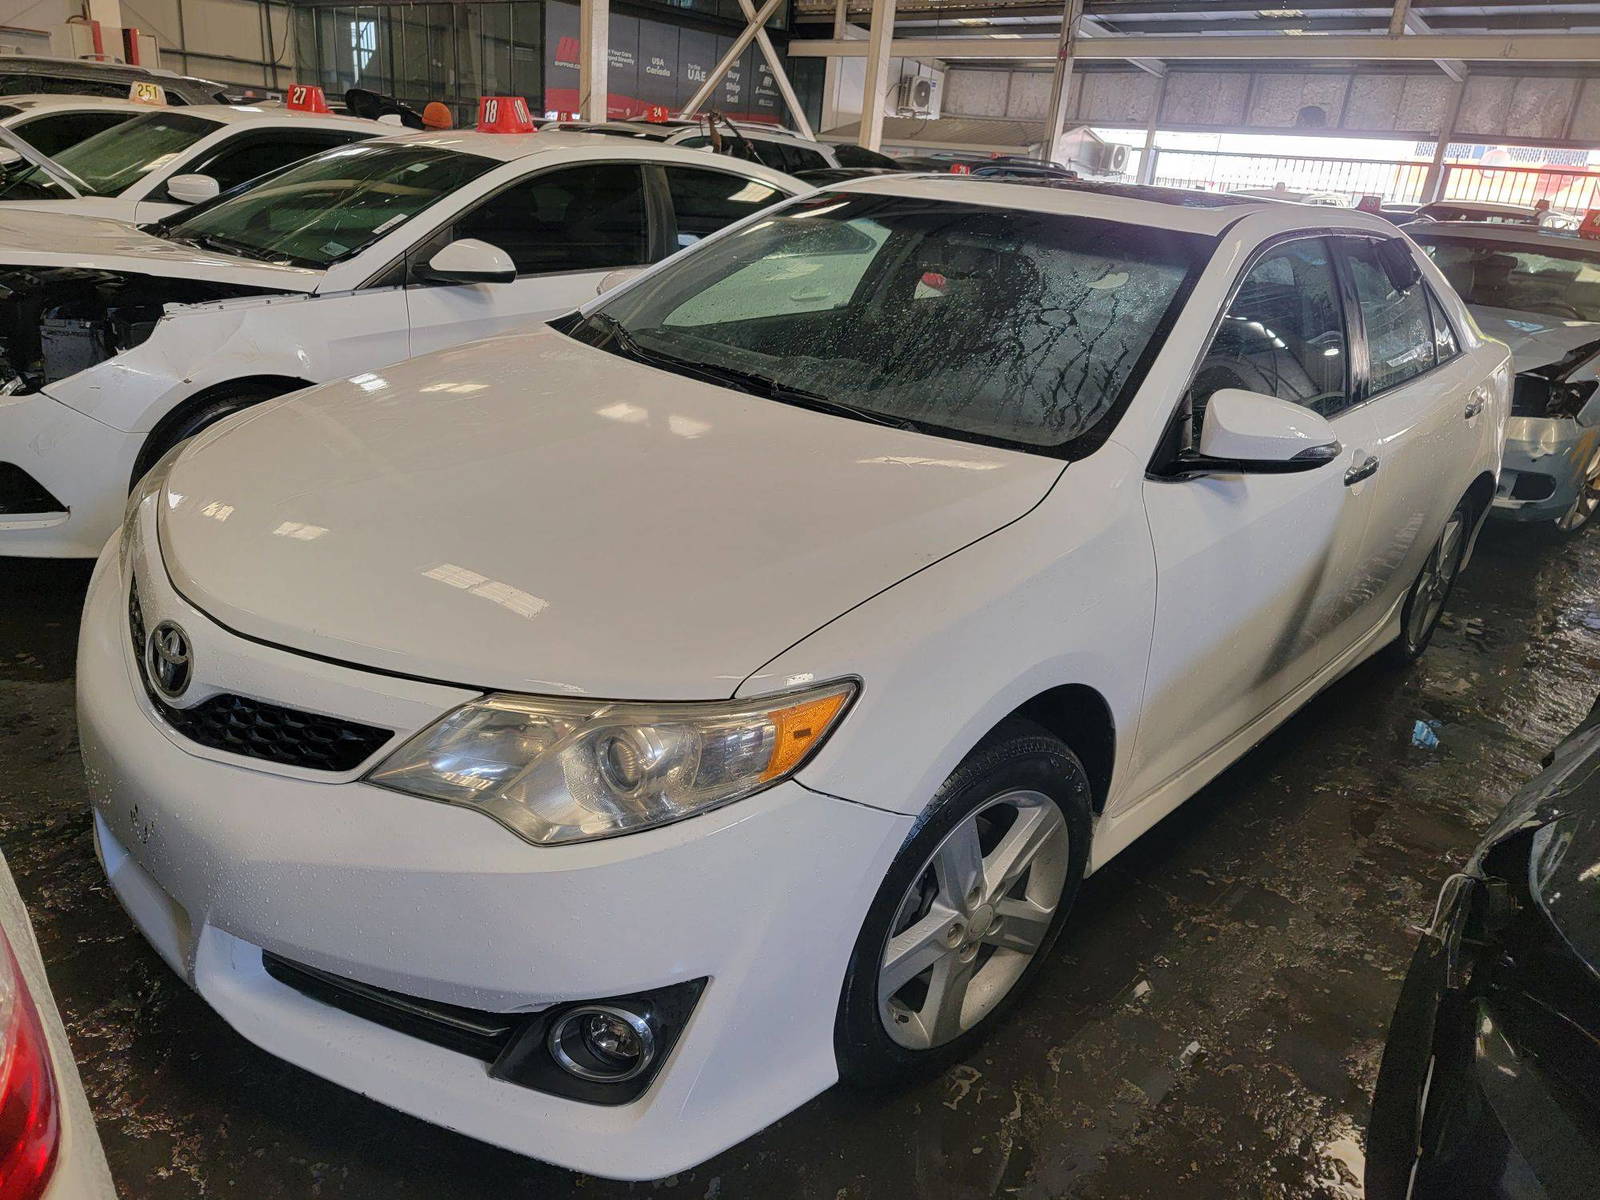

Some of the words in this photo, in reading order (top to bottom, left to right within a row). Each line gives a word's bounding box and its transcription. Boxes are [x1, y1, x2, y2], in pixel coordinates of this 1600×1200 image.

[651, 57, 665, 66] USA
[646, 66, 671, 77] Canada
[687, 69, 706, 82] UAE
[137, 83, 157, 99] 251
[293, 87, 307, 105] 27
[726, 94, 739, 104] Sell
[485, 99, 498, 123] 18
